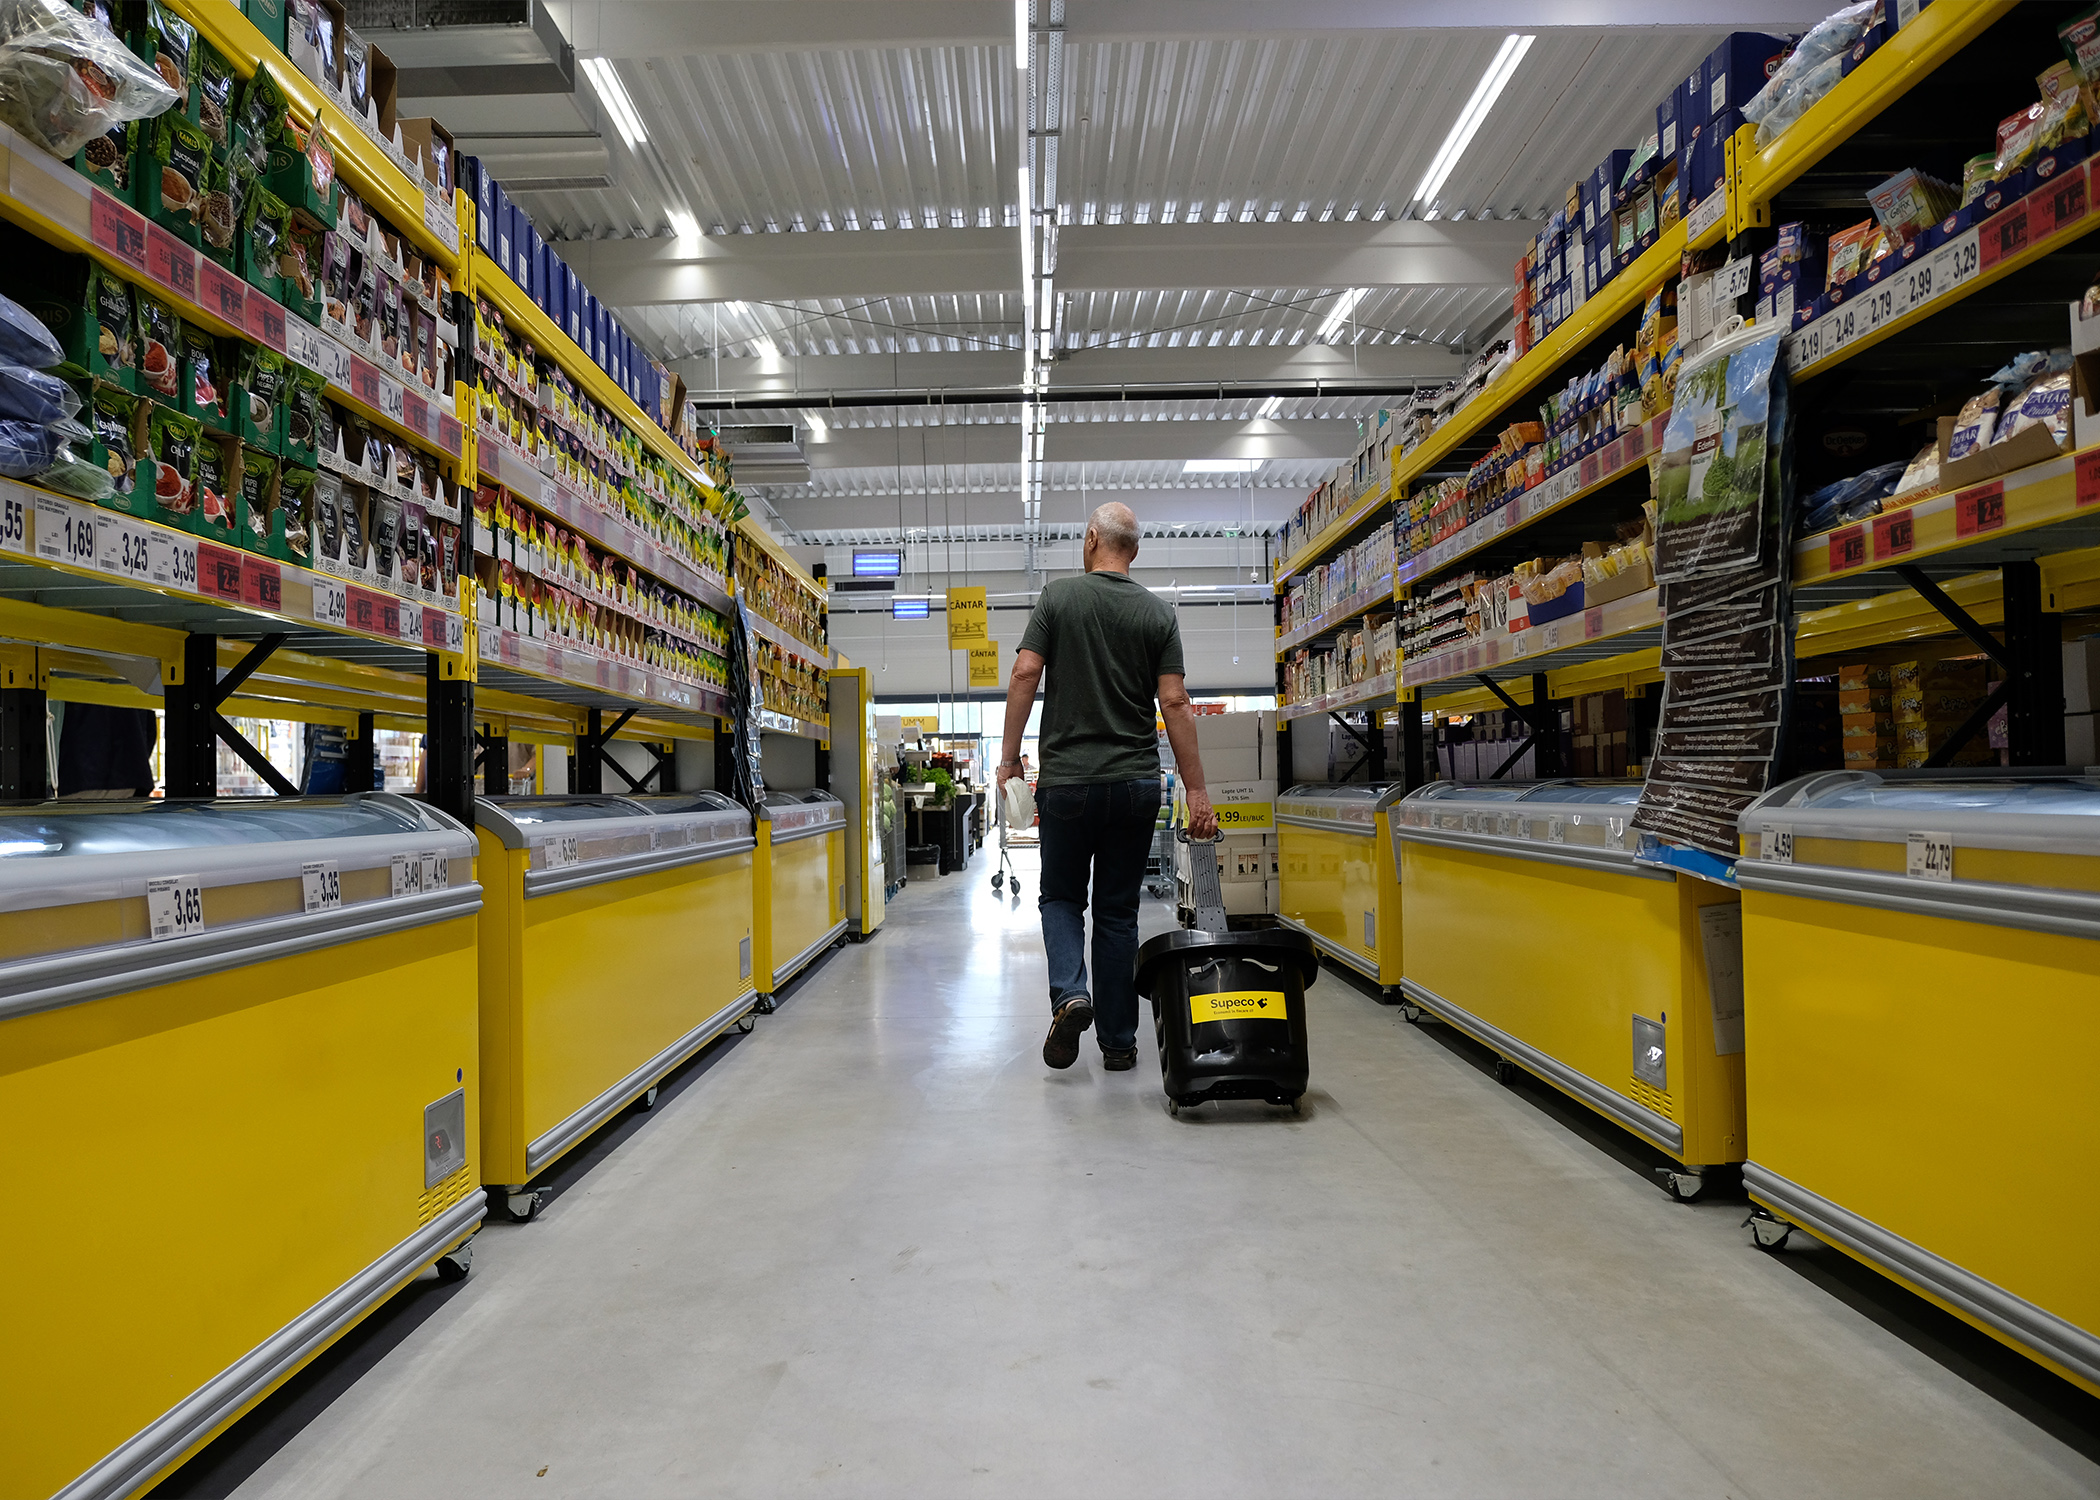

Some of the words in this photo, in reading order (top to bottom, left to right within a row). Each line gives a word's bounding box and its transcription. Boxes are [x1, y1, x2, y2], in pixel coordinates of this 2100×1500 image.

[178, 131, 199, 149] KAMIS
[1953, 242, 1977, 282] 3,29
[1730, 266, 1749, 296] 5,79
[1910, 268, 1932, 305] 2,99
[1871, 290, 1892, 326] 2,79
[1836, 312, 1855, 346] 2,49
[302, 332, 320, 368] 2,99
[1802, 331, 1819, 365] 2,19
[335, 352, 350, 387] 2,49
[170, 425, 186, 438] KAMIS
[1697, 439, 1715, 451] Edena
[1826, 435, 1867, 445] Dr.Oetker
[65, 516, 93, 562] 1,69
[123, 532, 148, 575] 3,25
[173, 546, 196, 587] 3,39
[328, 589, 346, 623] 2,99
[950, 600, 984, 610] CÂNTAR
[1215, 811, 1240, 822] 4.99
[562, 837, 577, 865] 6,99
[1774, 832, 1791, 862] 4,59
[1926, 843, 1950, 876] 22,79
[320, 871, 339, 903] 3,35
[405, 860, 419, 894] 5,49
[433, 858, 448, 889] 4,19
[174, 888, 200, 933] 3,65
[1211, 999, 1254, 1009] Supeco
